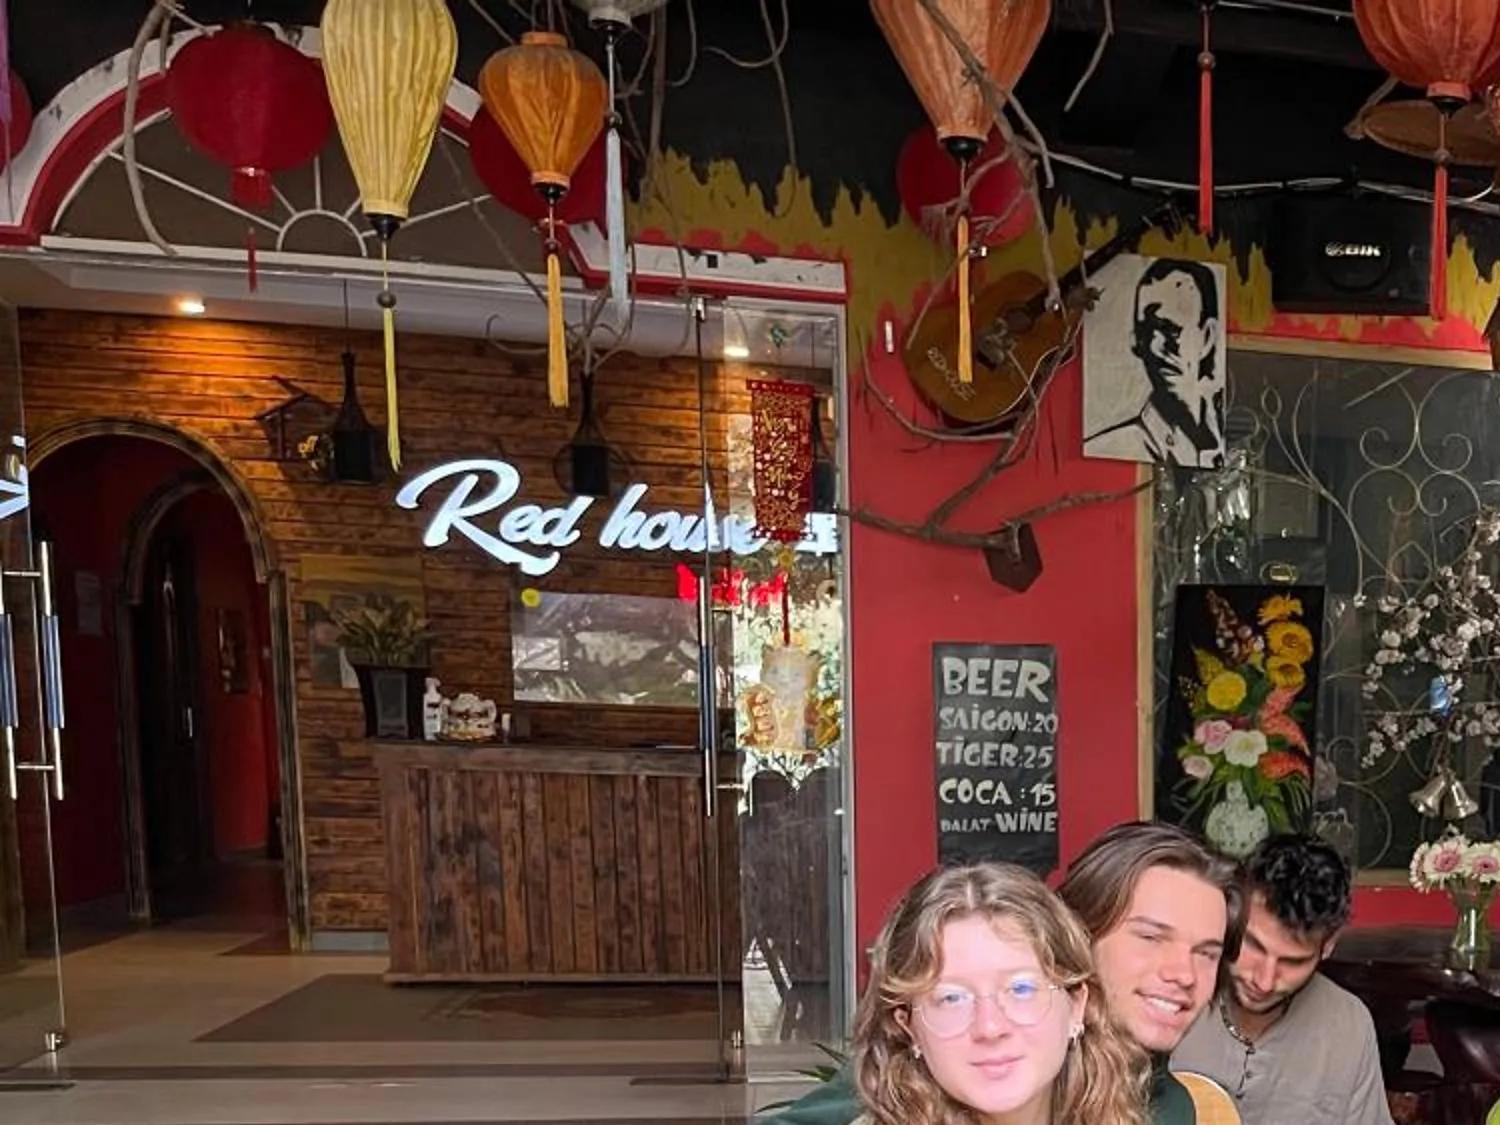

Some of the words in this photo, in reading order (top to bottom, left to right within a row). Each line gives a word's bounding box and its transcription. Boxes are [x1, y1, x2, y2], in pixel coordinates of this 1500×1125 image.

[395, 458, 595, 576] Red
[942, 656, 1051, 703] BEER
[939, 778, 1013, 805] COCA
